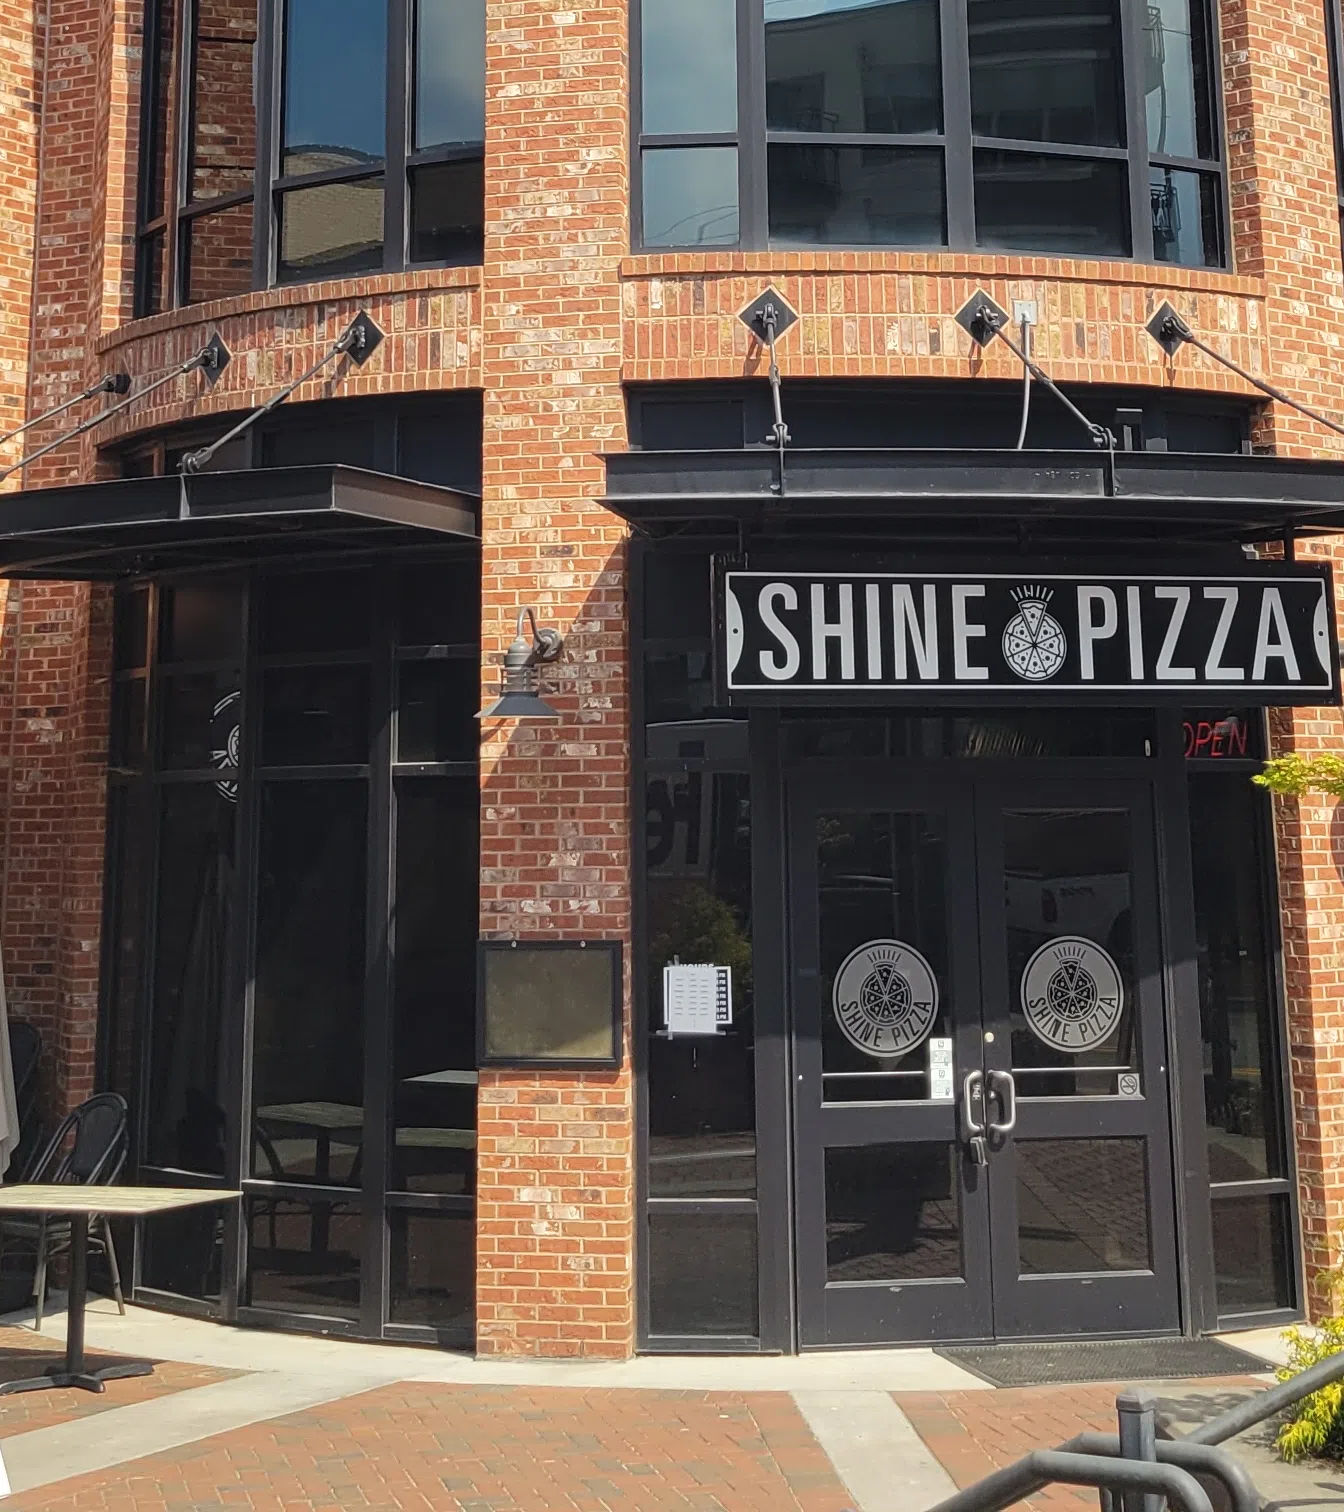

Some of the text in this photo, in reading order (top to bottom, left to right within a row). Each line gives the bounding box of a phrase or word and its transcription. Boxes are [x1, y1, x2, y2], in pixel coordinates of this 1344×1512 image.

[757, 582, 1302, 681] SHINE PIZZA
[840, 1000, 931, 1047] SHINE PIZZA
[1029, 997, 1117, 1043] SHINE PIZZA
